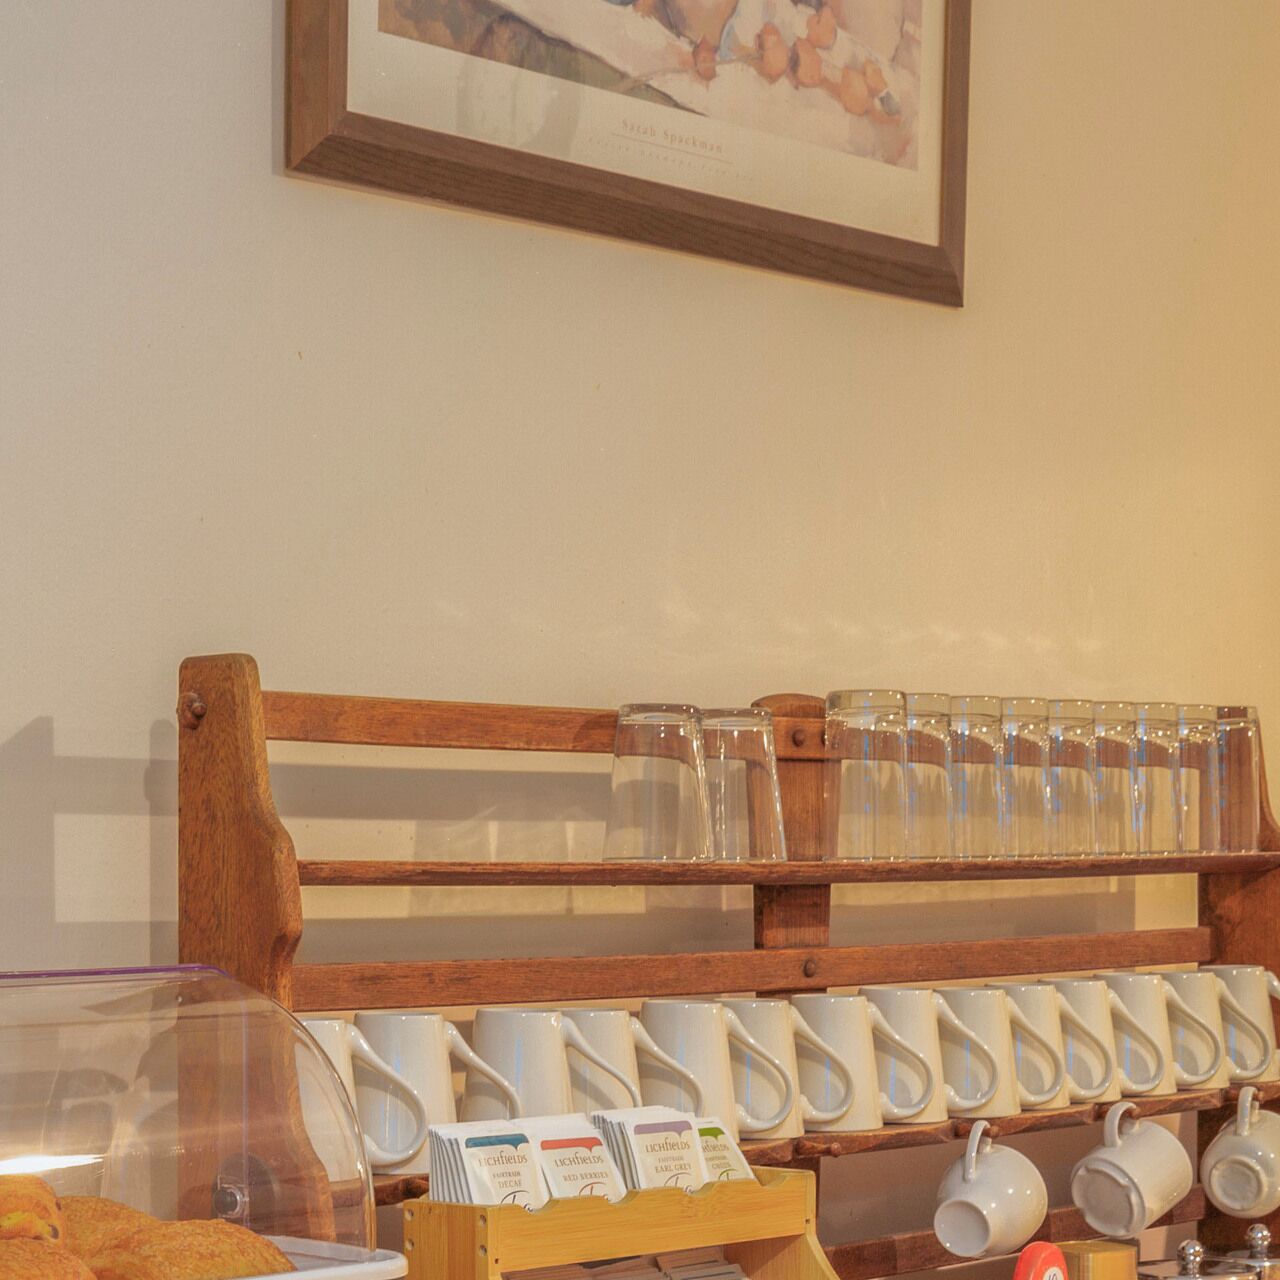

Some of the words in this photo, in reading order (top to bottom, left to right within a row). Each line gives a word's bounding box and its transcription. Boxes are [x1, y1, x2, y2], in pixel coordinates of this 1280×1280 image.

[655, 1165, 673, 1173] EARL
[674, 1162, 692, 1171] GREY
[562, 1174, 579, 1182] RED
[580, 1171, 609, 1180] BERRIES
